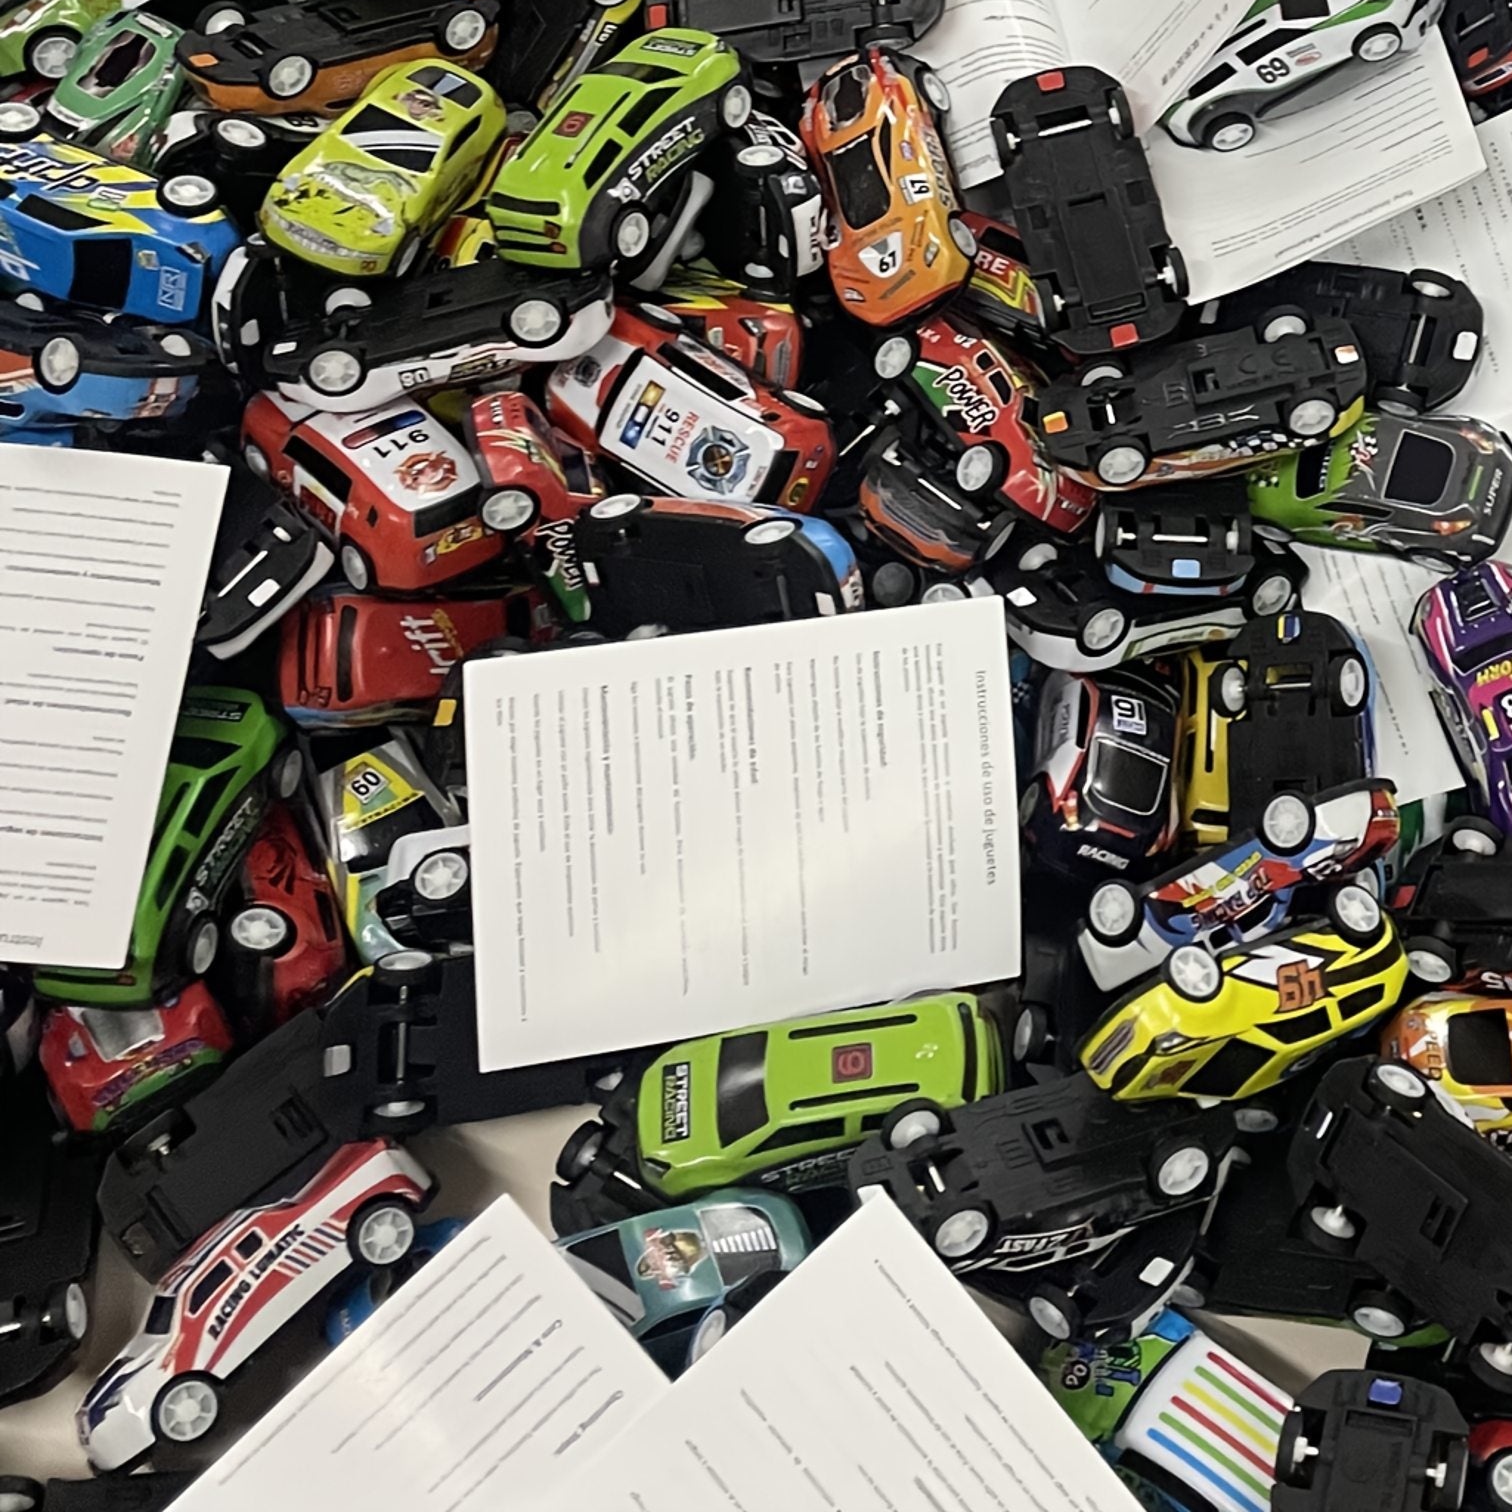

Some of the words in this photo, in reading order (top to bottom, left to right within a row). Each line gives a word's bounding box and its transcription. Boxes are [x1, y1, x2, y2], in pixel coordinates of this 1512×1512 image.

[1256, 57, 1290, 84] 69
[628, 117, 696, 180] STREET
[879, 251, 897, 273] 67
[932, 366, 999, 434] POWER
[651, 408, 680, 446] 911
[664, 411, 700, 464] RESCUE
[373, 430, 430, 458] 911
[974, 670, 991, 757] Instrucciones
[351, 770, 382, 797] 60
[980, 761, 992, 778] de
[981, 781, 992, 805] uso
[982, 809, 995, 826] de
[981, 828, 998, 885] juguetes
[1077, 844, 1130, 870] RACING
[208, 1275, 250, 1341] RACING
